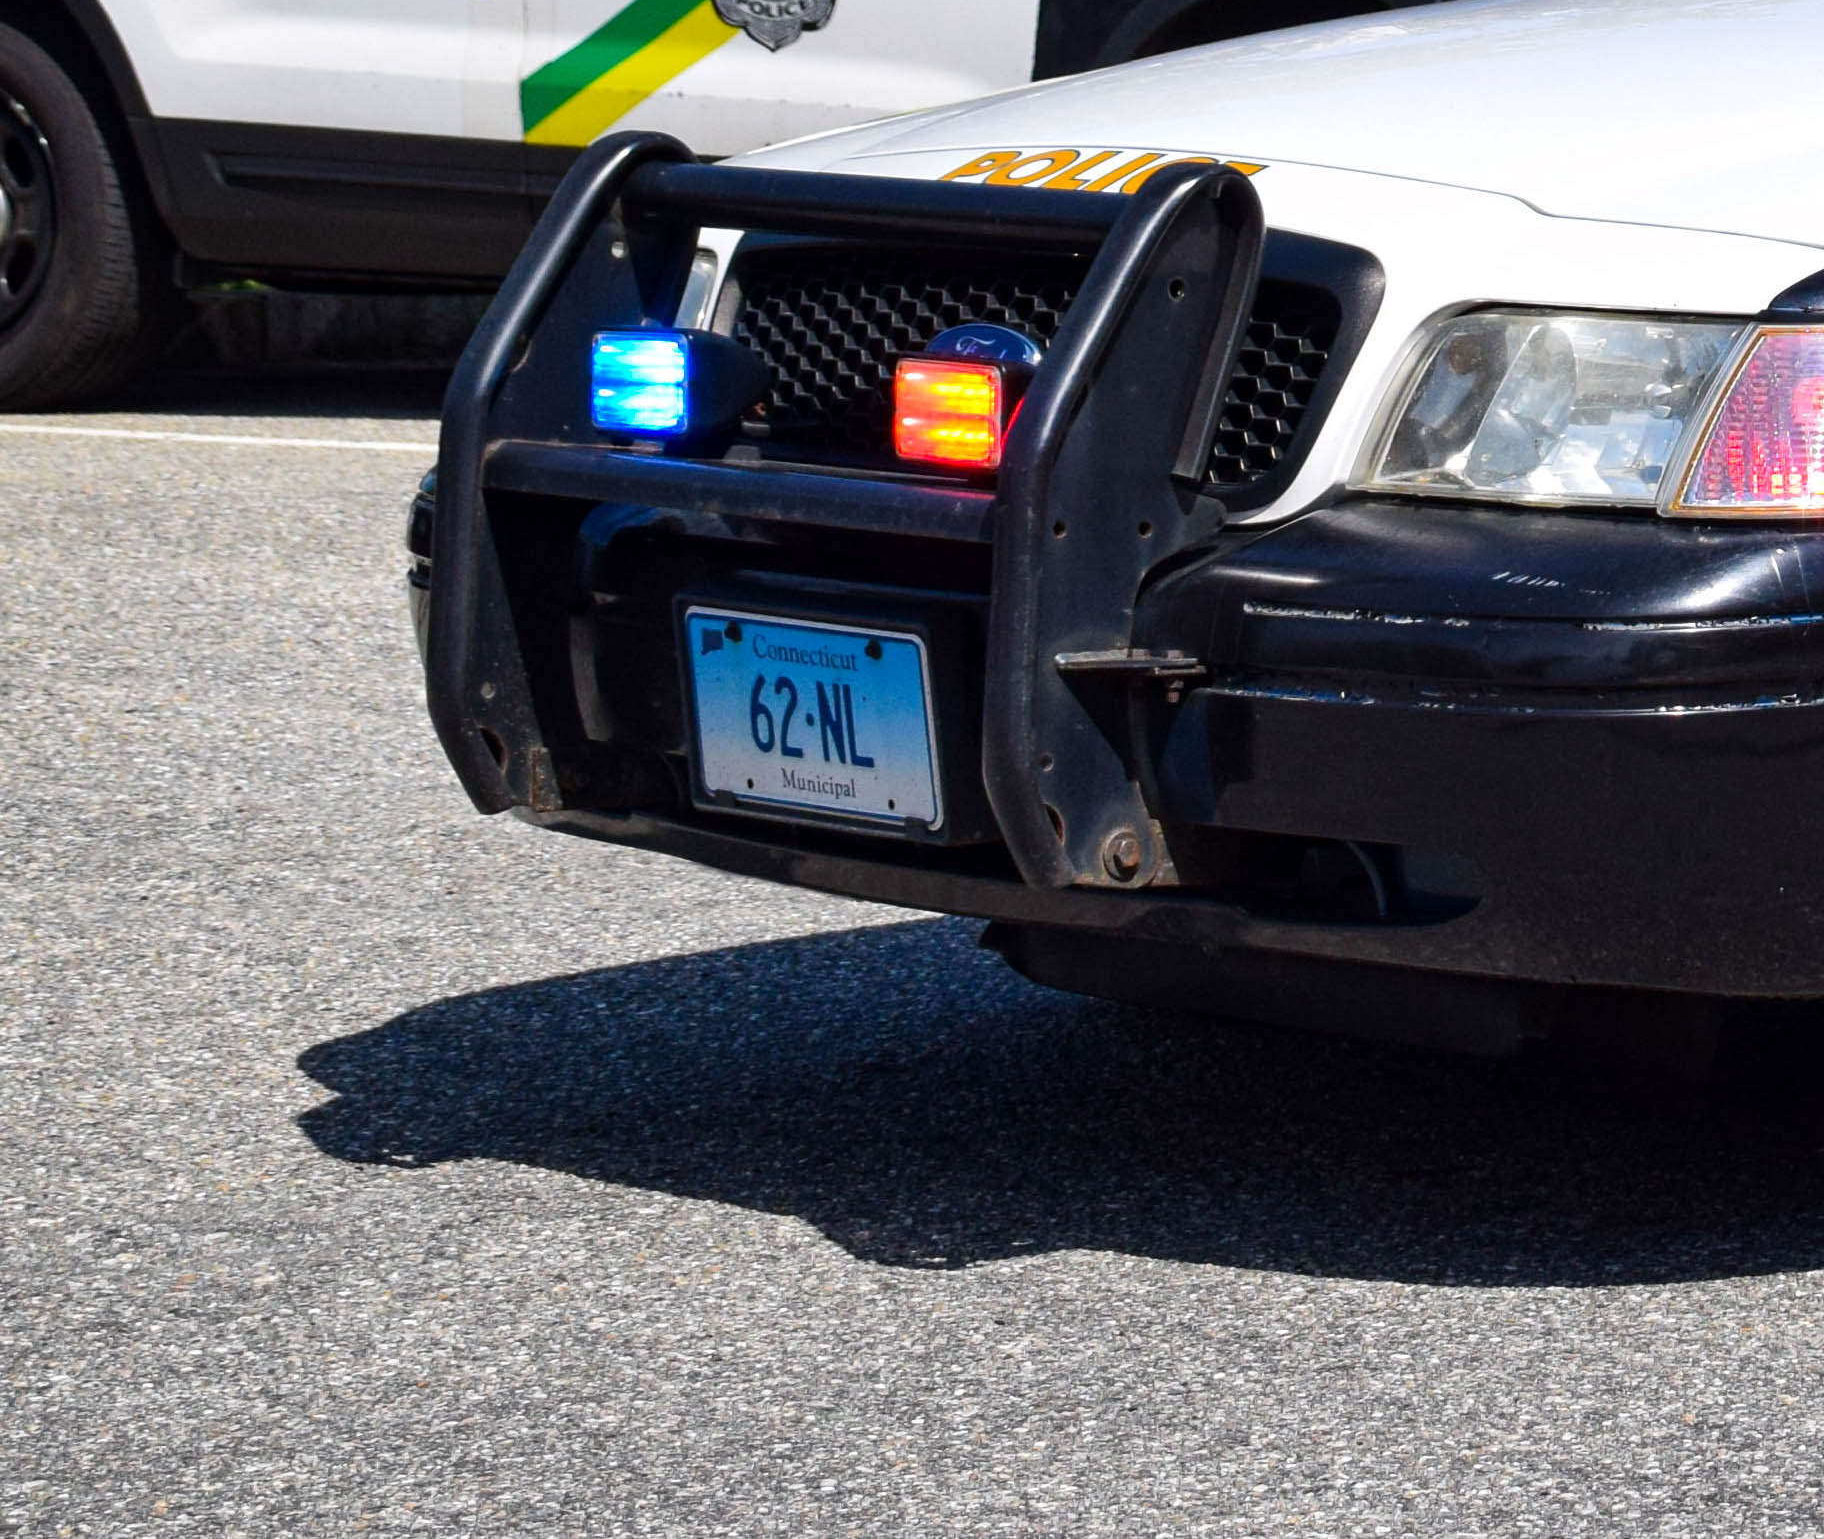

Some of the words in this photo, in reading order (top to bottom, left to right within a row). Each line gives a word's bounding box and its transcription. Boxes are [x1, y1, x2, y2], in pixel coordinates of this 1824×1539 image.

[941, 148, 1270, 195] POLIC
[753, 633, 857, 672] Connecticut
[780, 768, 856, 799] Municipal
